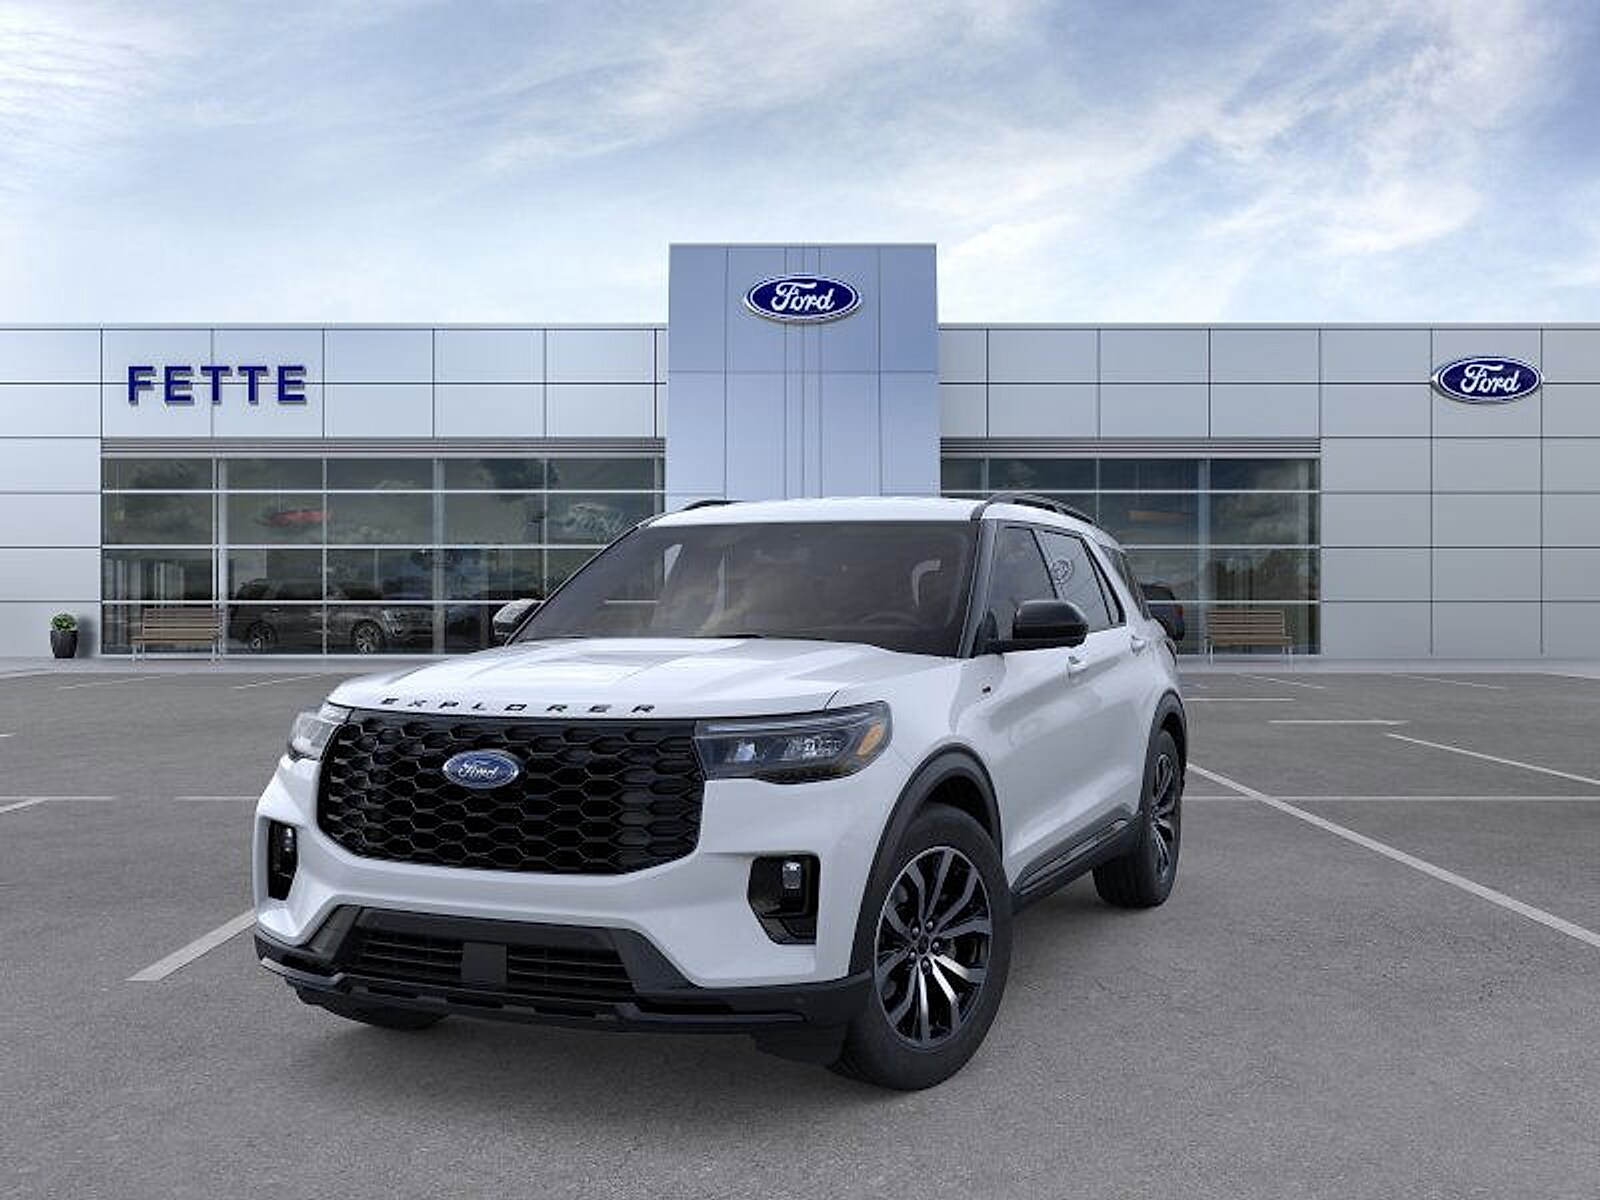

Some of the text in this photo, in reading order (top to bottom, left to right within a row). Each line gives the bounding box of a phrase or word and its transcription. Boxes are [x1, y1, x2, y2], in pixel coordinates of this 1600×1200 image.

[771, 282, 835, 311] Ford
[128, 365, 307, 405] FETTE
[1461, 364, 1521, 393] Ford
[380, 697, 655, 713] EXPLORER
[458, 760, 499, 779] Ford
